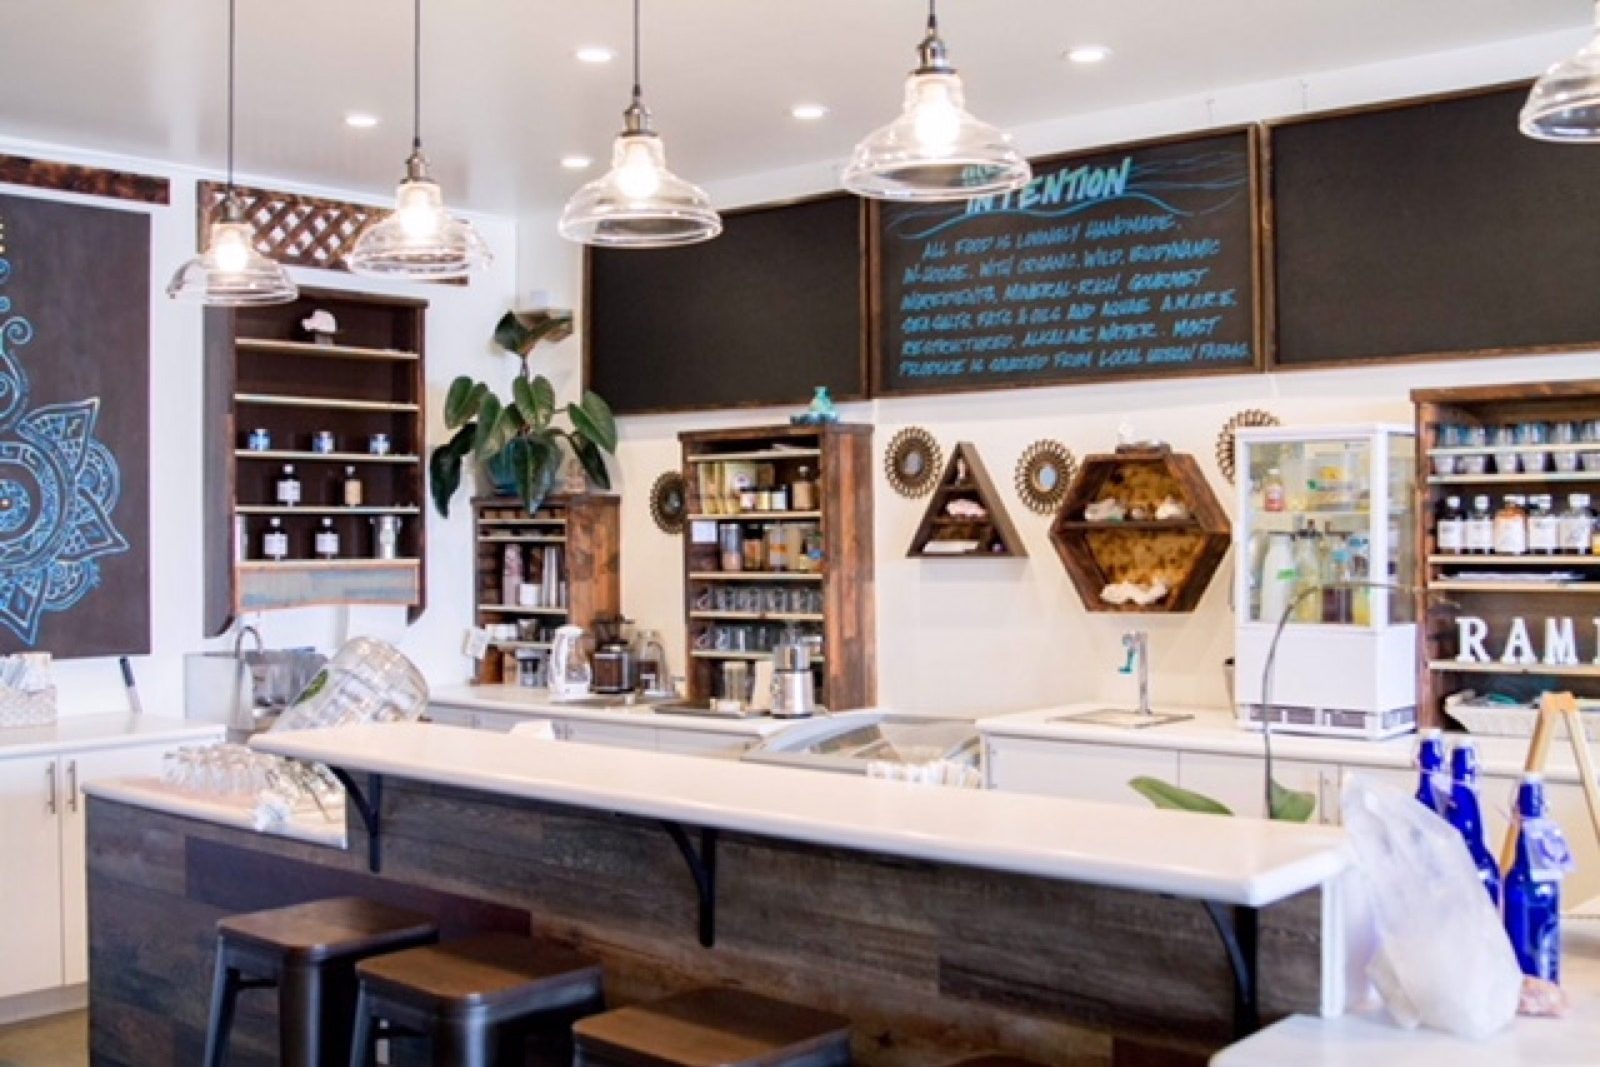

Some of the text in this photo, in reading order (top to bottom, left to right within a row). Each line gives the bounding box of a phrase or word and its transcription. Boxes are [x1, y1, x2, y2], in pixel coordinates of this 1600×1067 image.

[922, 239, 948, 261] ALL
[1067, 303, 1096, 322] AND
[1053, 350, 1093, 369] FROM
[1099, 348, 1143, 368] LOCAL
